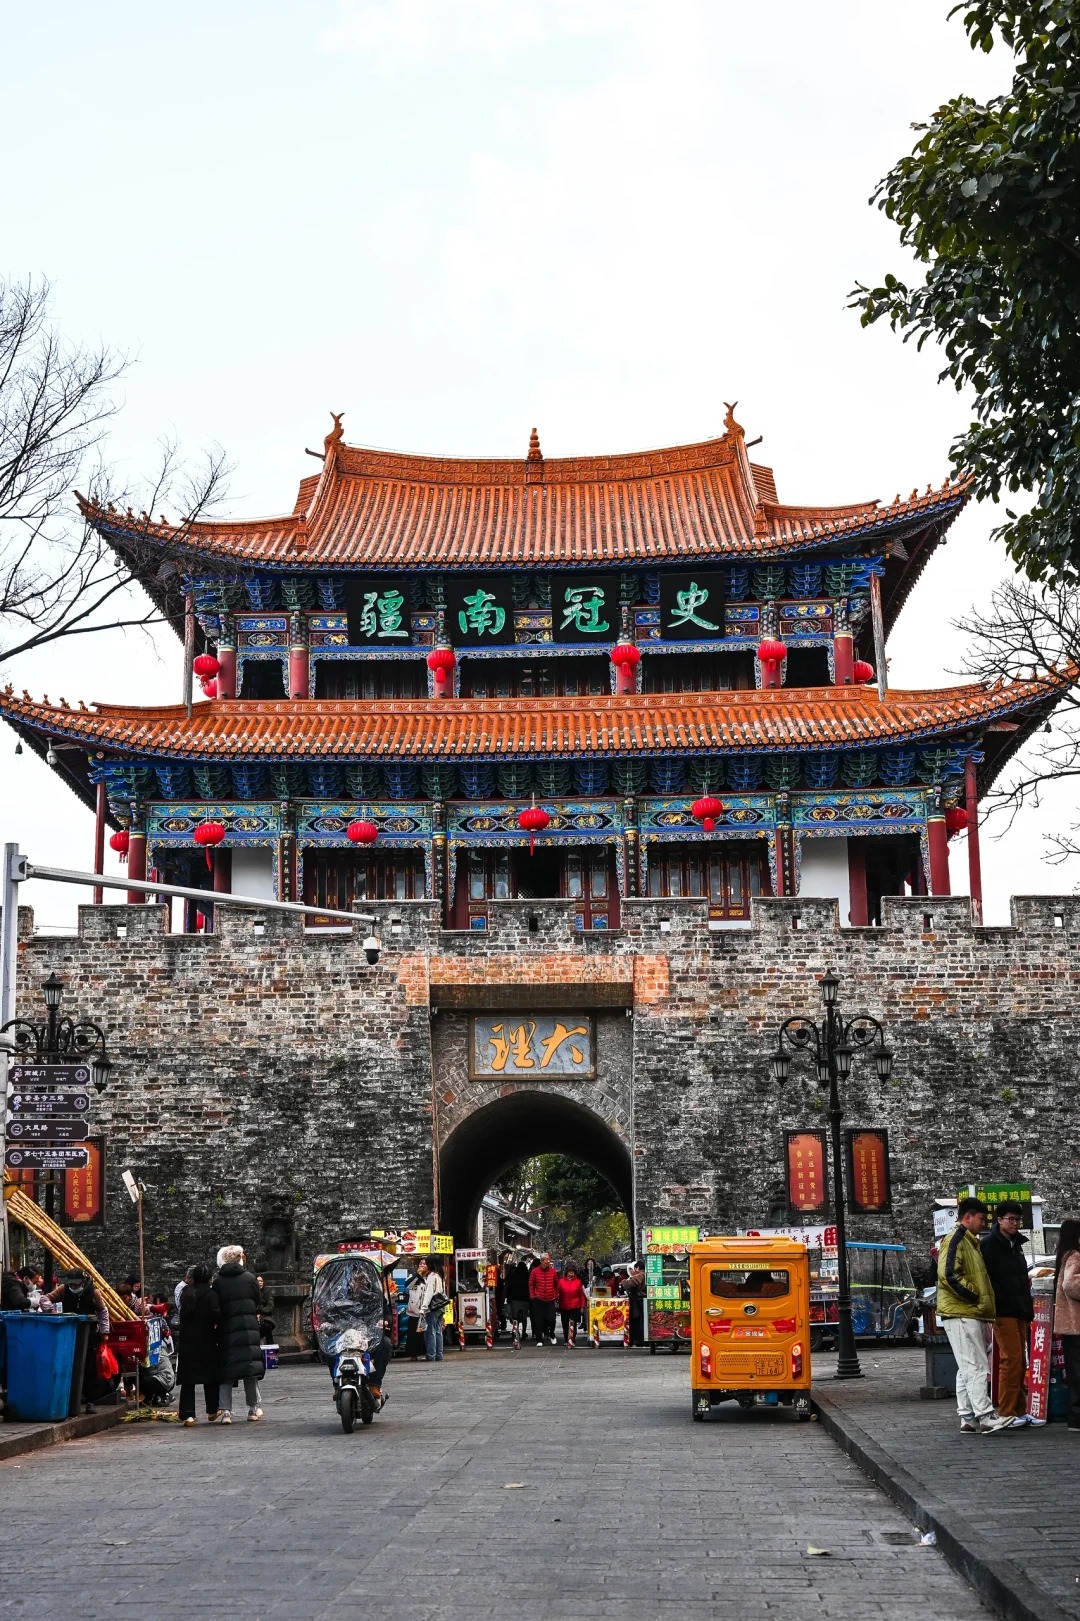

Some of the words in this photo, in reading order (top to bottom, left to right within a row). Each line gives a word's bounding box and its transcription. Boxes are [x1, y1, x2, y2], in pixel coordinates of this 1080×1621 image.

[489, 1020, 588, 1071] 大理
[796, 1150, 805, 1201] 奋进新征程
[807, 1150, 817, 1200] 永远跟党走
[487, 1265, 496, 1286] 烤乳扇
[1030, 1327, 1045, 1419] 烤乳扇
